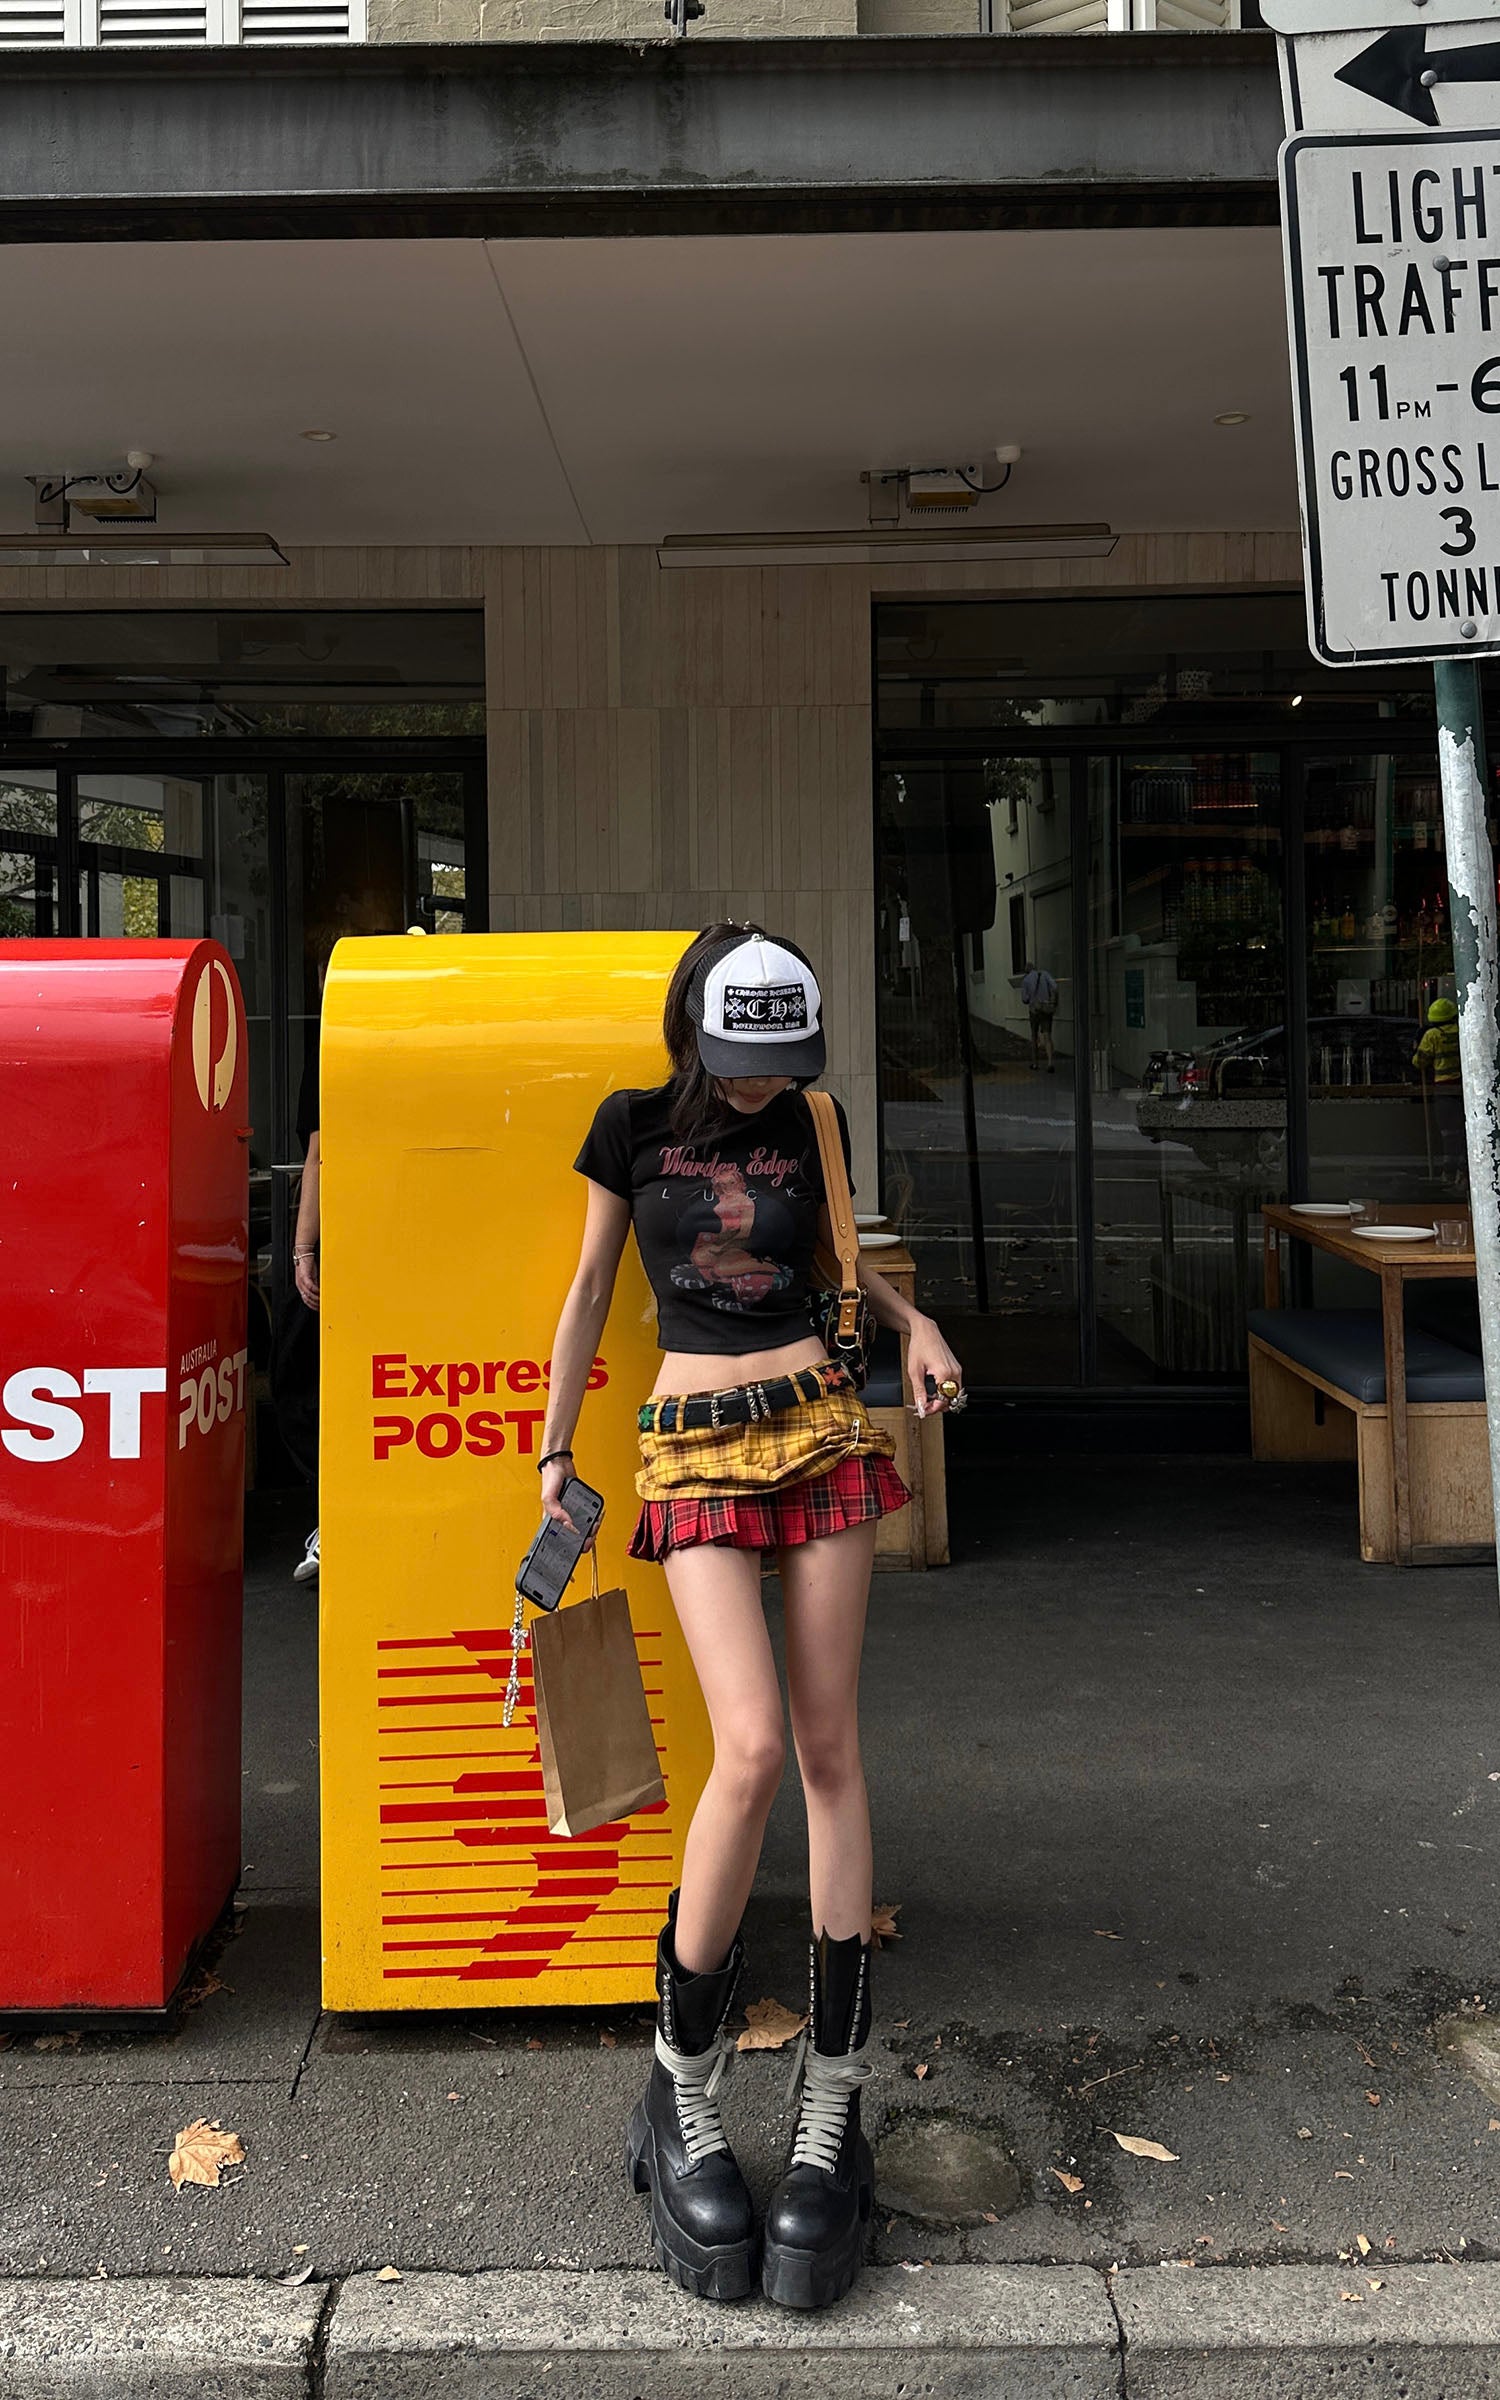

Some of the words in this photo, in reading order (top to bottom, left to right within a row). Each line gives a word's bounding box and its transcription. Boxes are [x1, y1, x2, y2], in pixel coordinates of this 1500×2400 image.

[1352, 166, 1500, 243] LIGH
[1331, 444, 1464, 500] GROSS
[1438, 506, 1476, 556] 3
[746, 1147, 798, 1187] Edge
[180, 1339, 218, 1375] AUSTRALIA
[0, 1366, 167, 1462] ST
[179, 1348, 248, 1450] POST
[374, 1410, 545, 1460] POST
